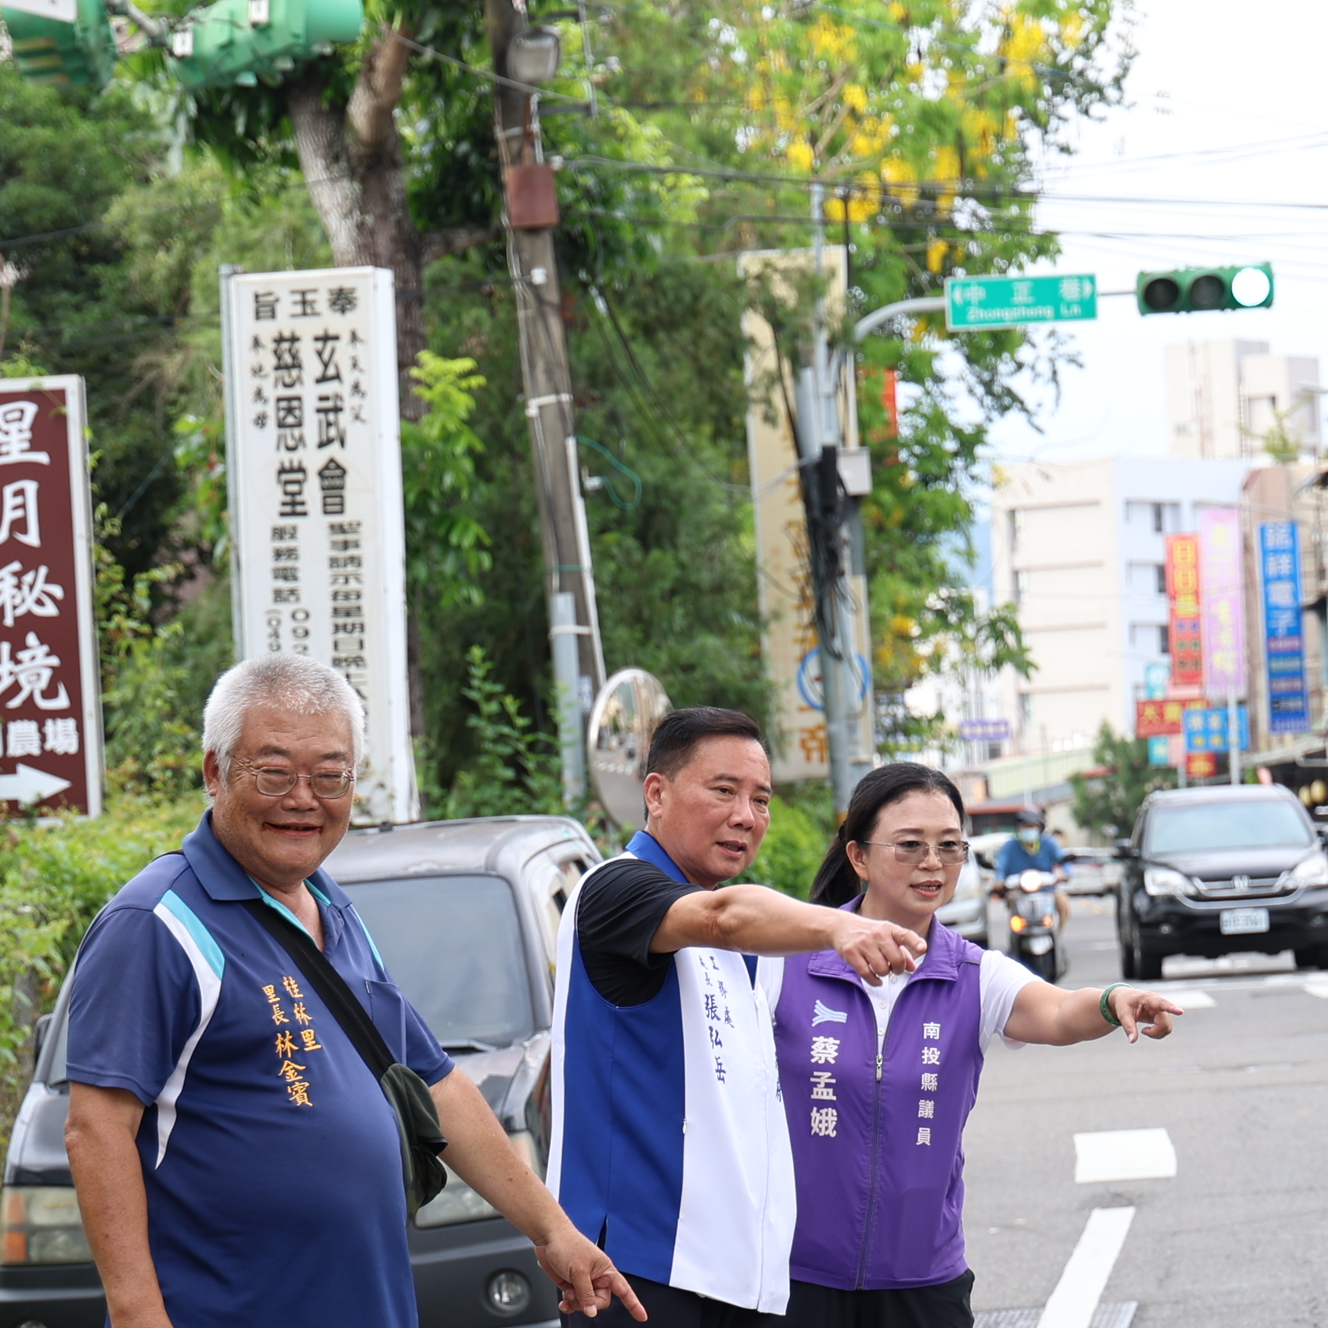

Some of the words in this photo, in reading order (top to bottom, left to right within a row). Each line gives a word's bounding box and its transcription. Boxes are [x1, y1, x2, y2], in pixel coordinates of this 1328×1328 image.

[272, 331, 309, 518] 慈恩堂
[313, 327, 348, 516] 玄武會
[282, 976, 322, 1052] 桂林里
[810, 1036, 840, 1138] 蔡孟娥
[915, 1022, 941, 1146] 南投縣議員
